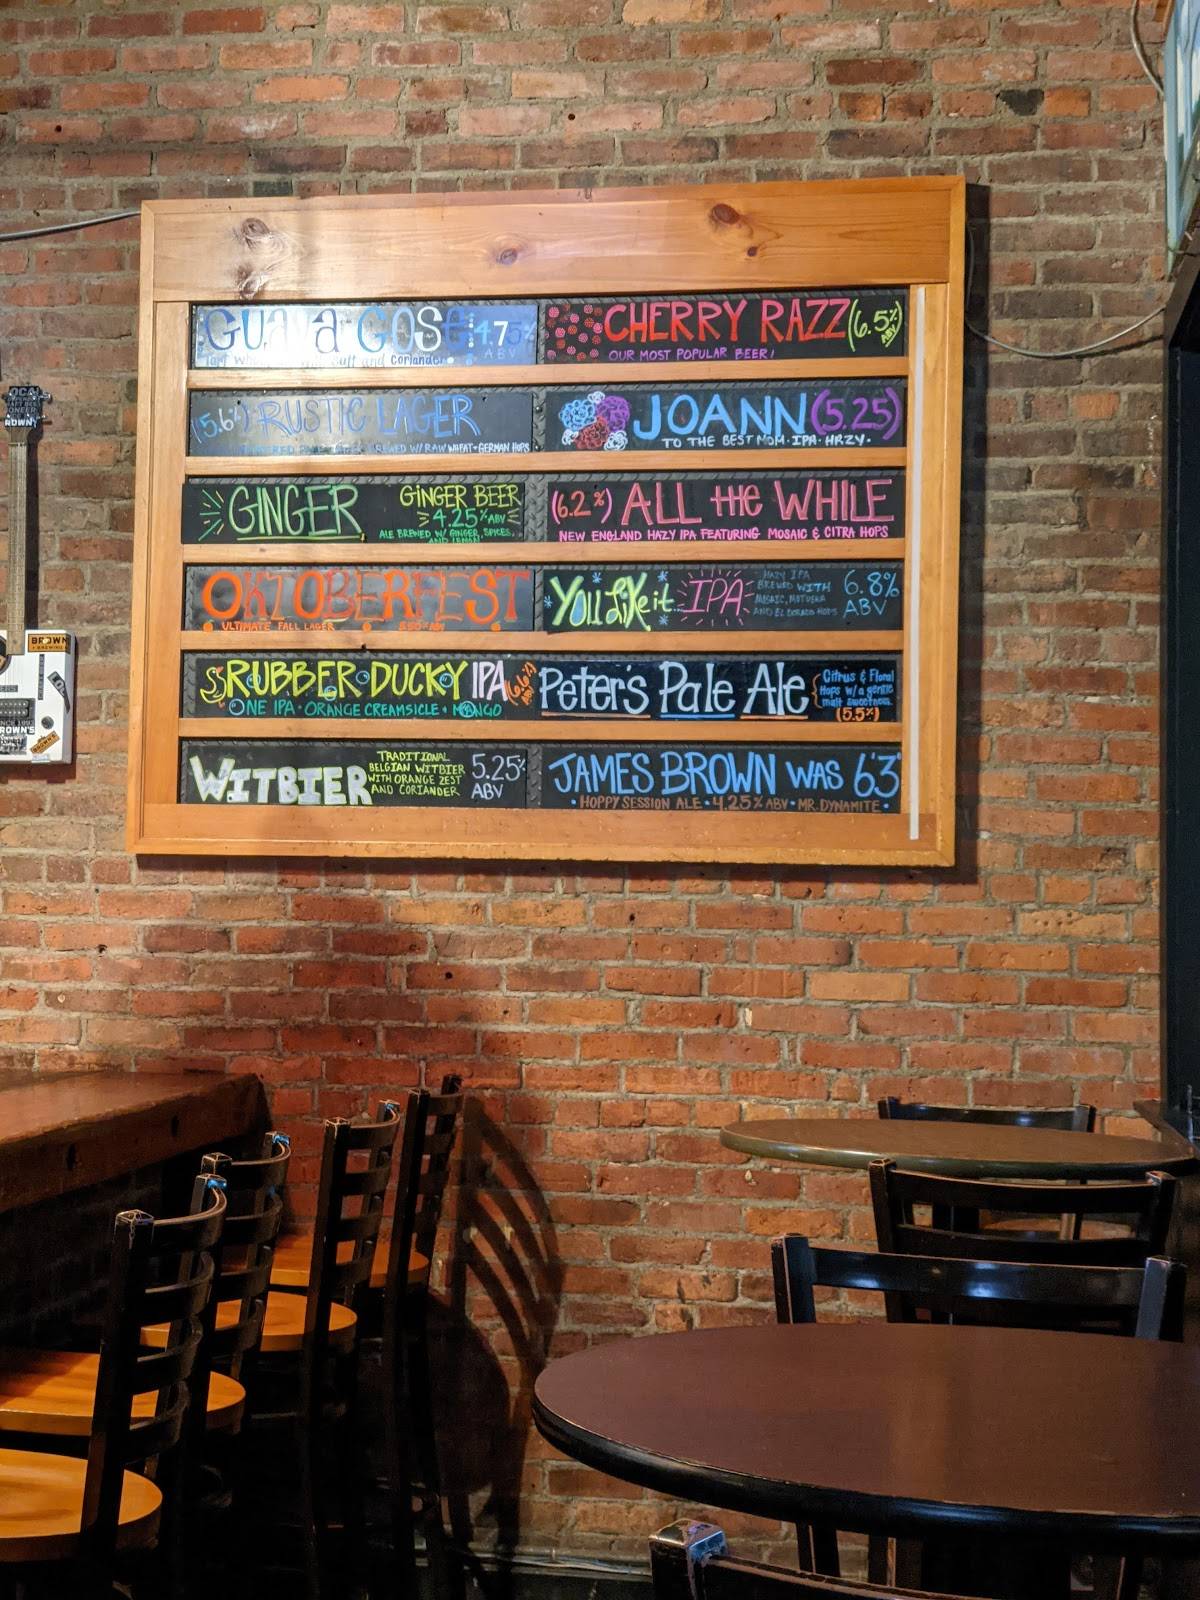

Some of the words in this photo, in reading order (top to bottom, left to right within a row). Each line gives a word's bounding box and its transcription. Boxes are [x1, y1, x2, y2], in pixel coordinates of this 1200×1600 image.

[603, 299, 748, 344] CHERRY
[760, 298, 851, 344] RAZZ
[608, 349, 635, 361] OUR
[639, 350, 671, 361] MOST
[676, 346, 728, 360] POPULAR
[257, 396, 367, 438] RUSTIC
[375, 393, 482, 438] LAGER
[633, 393, 807, 440] JOANN
[811, 387, 902, 440] (5.25)
[512, 441, 530, 453] HOPS
[661, 437, 682, 448] TO
[687, 435, 715, 447] THE
[722, 433, 754, 446] BEST
[473, 484, 522, 508] BEER
[620, 482, 703, 526] ALL
[774, 479, 895, 522] WHILE
[228, 484, 363, 536] GINGER
[487, 514, 506, 525] ABV
[379, 529, 395, 540] ALE
[397, 528, 431, 539] BREWED
[559, 530, 585, 542] NEW
[591, 529, 642, 542] ENGLAND
[647, 529, 676, 541] HAZY
[680, 529, 697, 541] IPA
[700, 527, 761, 541] FEATURING
[768, 527, 808, 541] MOSAIC
[812, 527, 820, 541] &
[824, 526, 857, 539] CITRA
[860, 526, 889, 539] HOPS
[796, 581, 831, 593] WITH
[843, 569, 900, 598] 6.8%
[202, 567, 531, 625] OKTOBERFEST
[683, 578, 744, 617] IPA
[842, 597, 888, 619] ABV
[221, 620, 272, 632] ULTIMATE
[278, 620, 300, 631] FALL
[304, 621, 335, 631] LAGER
[226, 659, 363, 698] RUBBER
[370, 660, 469, 701] DUCKY
[472, 660, 509, 702] IPA
[822, 668, 856, 683] Citrus
[859, 668, 867, 684] &
[869, 668, 895, 683] Floral
[538, 664, 650, 715] Peter's
[658, 660, 736, 713] Pale
[742, 662, 810, 716] Ale
[229, 698, 268, 716] ONE
[274, 700, 295, 717] IPA
[304, 701, 361, 717] ORANGE
[364, 702, 439, 717] CREAMSICLE
[377, 750, 451, 763] TRADITIONAL
[368, 761, 411, 773] BELGIAN
[415, 763, 465, 776] WITBIER
[471, 753, 526, 782] 5.25%
[548, 752, 655, 794] JAMES
[660, 751, 777, 795] BROWN
[785, 760, 844, 790] WAS
[189, 755, 374, 806] WITBIER
[367, 773, 392, 784] WITH
[394, 774, 435, 785] ORANGE
[439, 775, 462, 786] ZEST
[371, 784, 394, 795] AND
[399, 784, 461, 797] CORIANDER
[471, 783, 504, 800] ABV
[579, 795, 621, 809] HOPPY
[621, 795, 671, 810] SESSION
[676, 796, 703, 810] ALE
[712, 795, 763, 811] 4.25%
[765, 797, 788, 810] ABV
[819, 798, 882, 813] DYNAMITE
